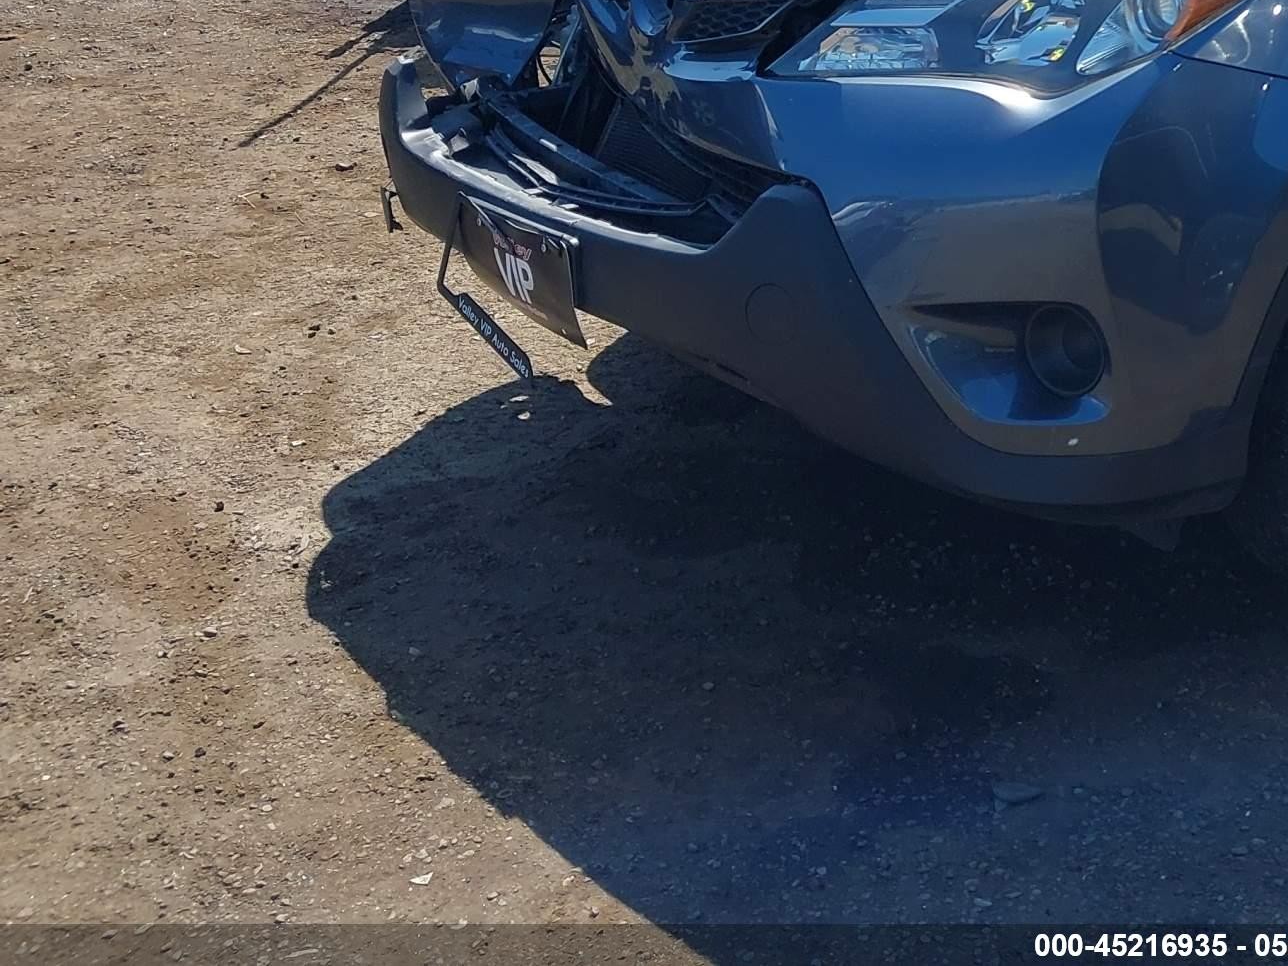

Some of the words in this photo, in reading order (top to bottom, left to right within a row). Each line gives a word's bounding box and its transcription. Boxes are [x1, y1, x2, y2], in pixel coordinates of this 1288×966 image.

[493, 247, 534, 304] VIP
[458, 296, 480, 326] Valley
[480, 318, 492, 337] VIP
[492, 333, 509, 356] Auto
[509, 351, 529, 379] Sales
